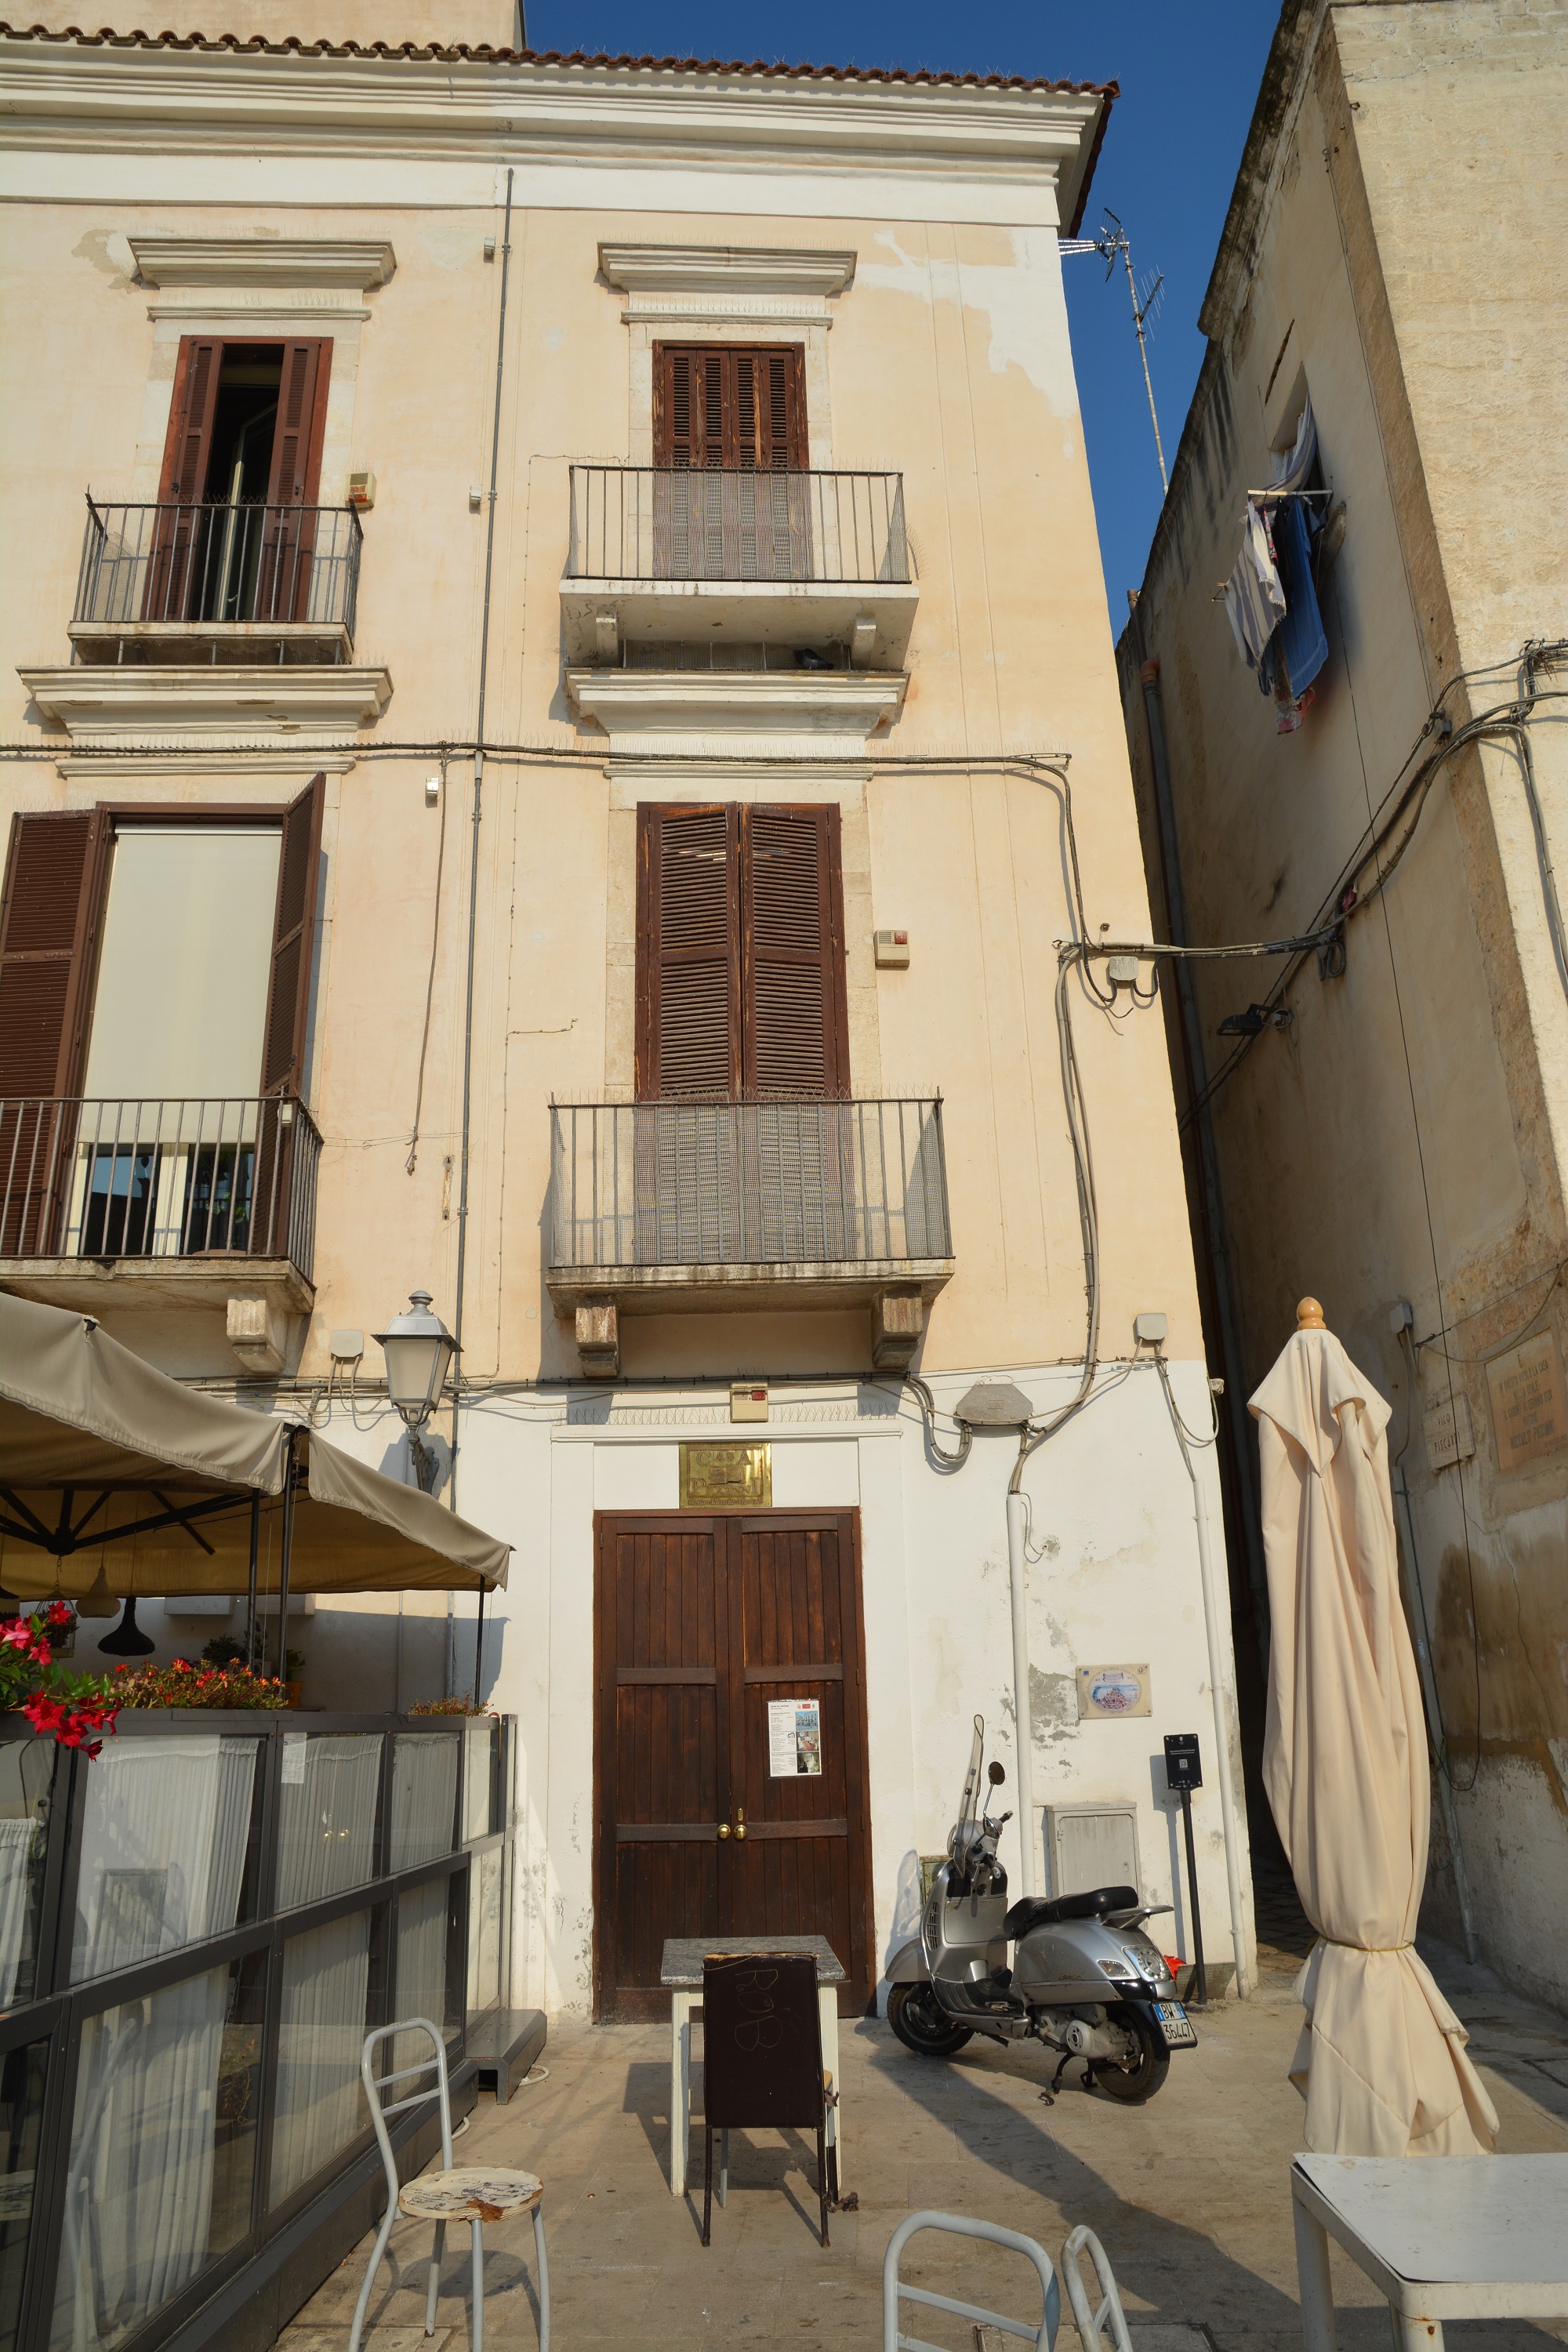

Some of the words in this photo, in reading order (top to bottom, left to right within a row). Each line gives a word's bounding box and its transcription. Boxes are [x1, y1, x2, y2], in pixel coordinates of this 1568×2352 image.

[1537, 1359, 1548, 1373] CASA
[1437, 1414, 1450, 1426] VICO
[696, 1450, 752, 1466] CASA
[690, 1477, 760, 1496] PICCINNI
[1160, 2004, 1174, 2019] BW
[1163, 2023, 1191, 2039] 36447
